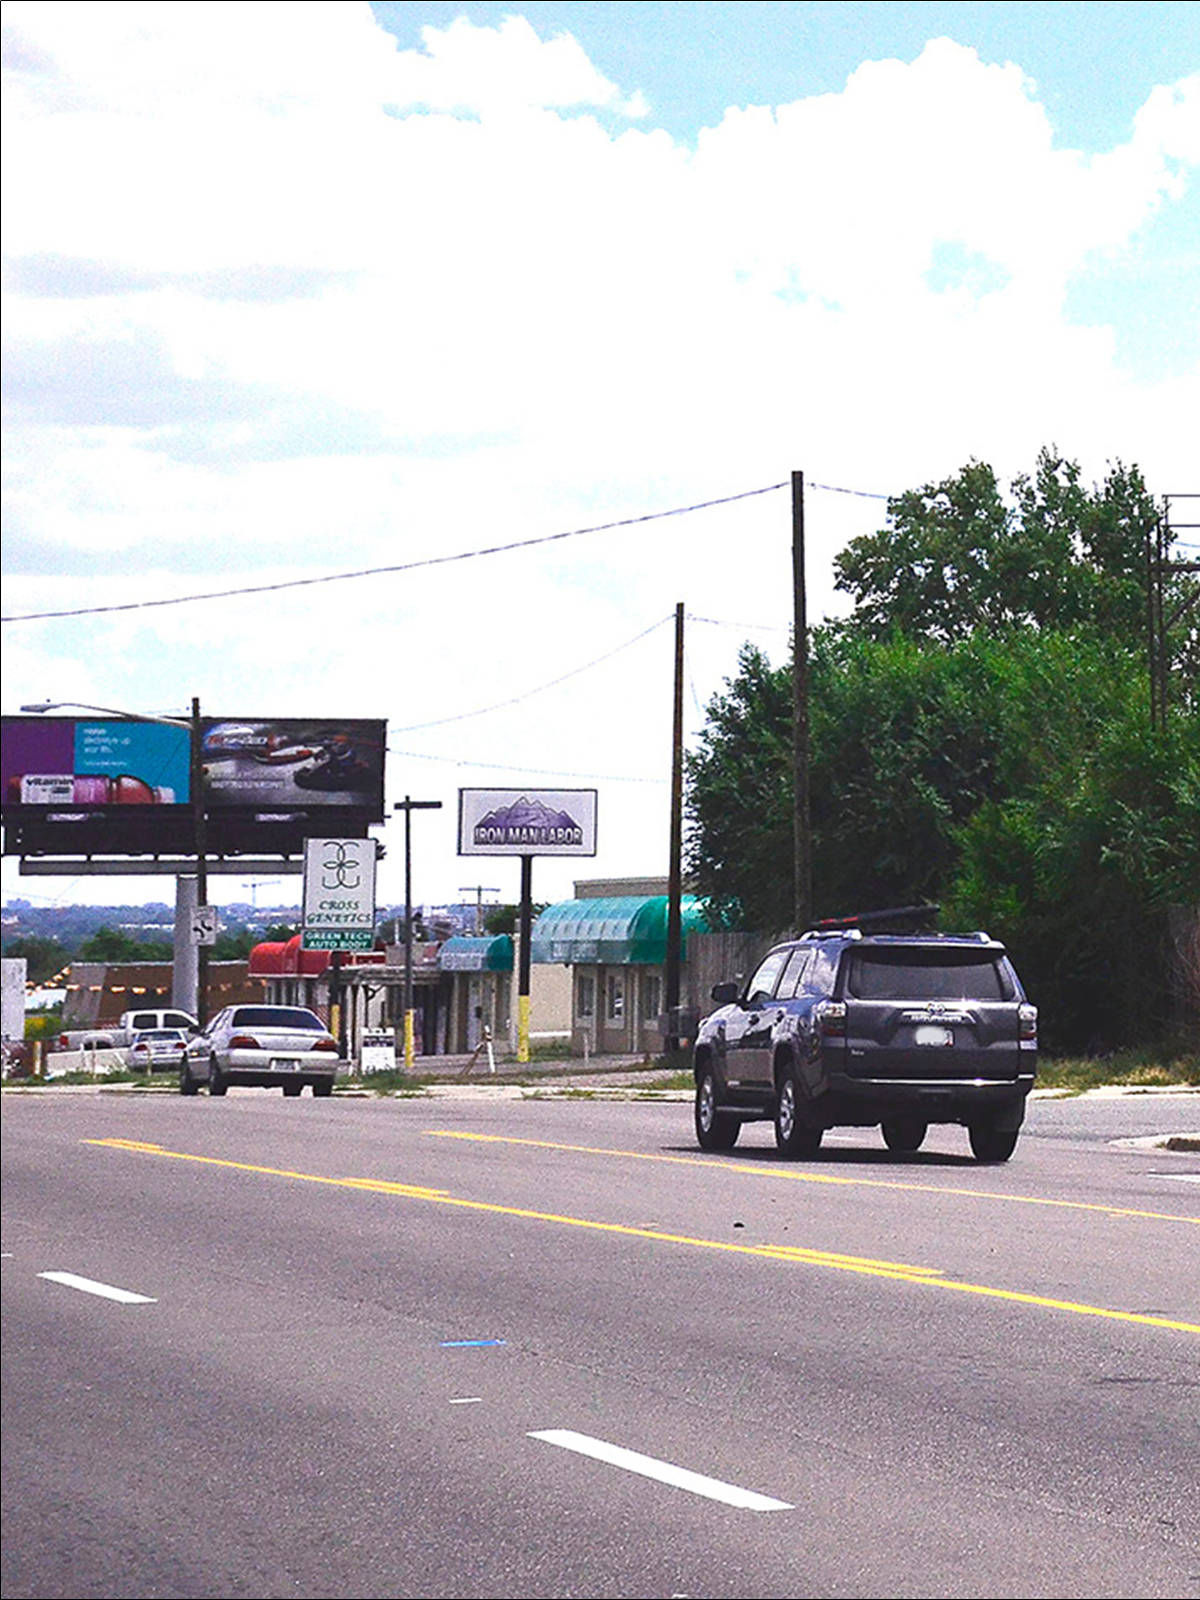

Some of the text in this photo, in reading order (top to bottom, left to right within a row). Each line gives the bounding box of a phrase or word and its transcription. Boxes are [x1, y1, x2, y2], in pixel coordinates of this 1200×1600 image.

[474, 826, 582, 844] IRON MAN LABOR
[319, 900, 360, 910] CROSS
[307, 912, 372, 924] GENETICS
[305, 930, 372, 940] GREEN TECH
[309, 940, 368, 949] AUTO BODY
